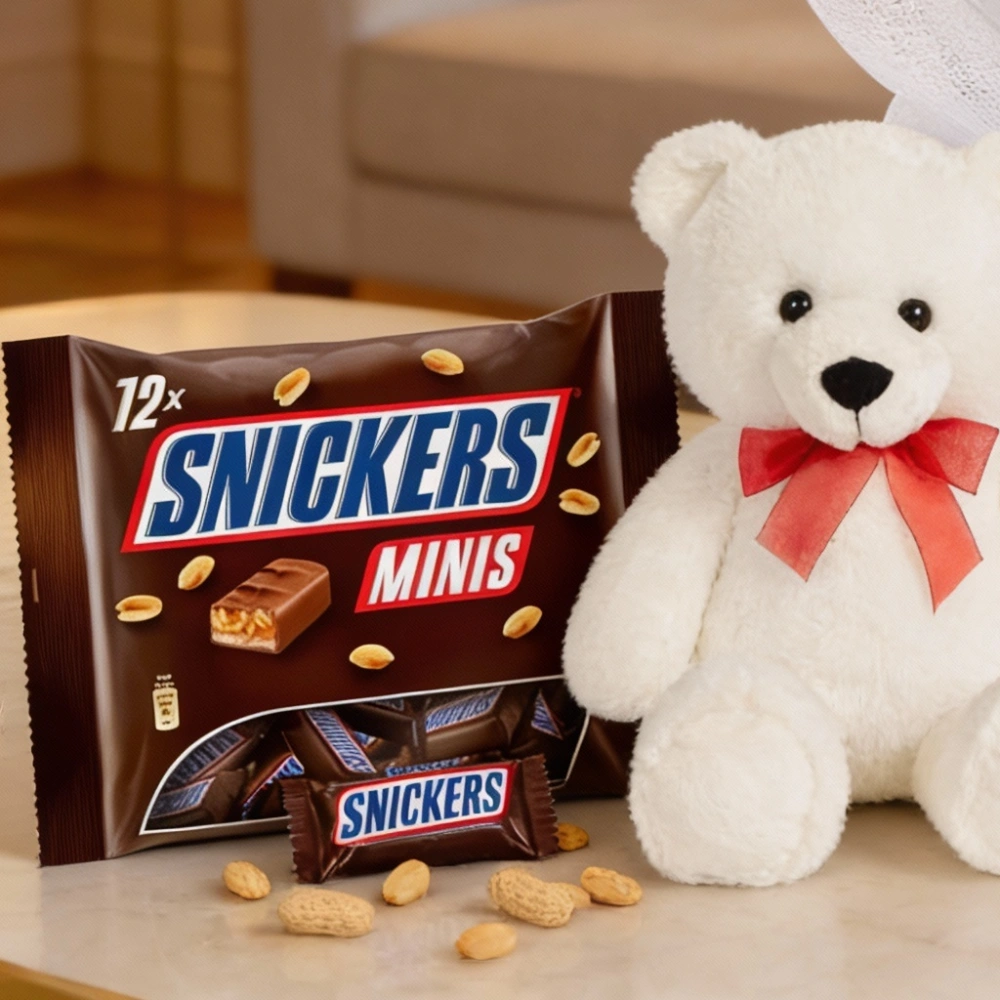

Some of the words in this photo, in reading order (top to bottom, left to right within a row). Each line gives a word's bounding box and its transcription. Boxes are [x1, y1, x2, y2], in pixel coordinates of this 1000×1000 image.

[111, 374, 187, 433] 12x
[144, 402, 551, 537] SNICKERS
[367, 533, 522, 605] MINIS
[340, 771, 503, 840] SNICKERS
